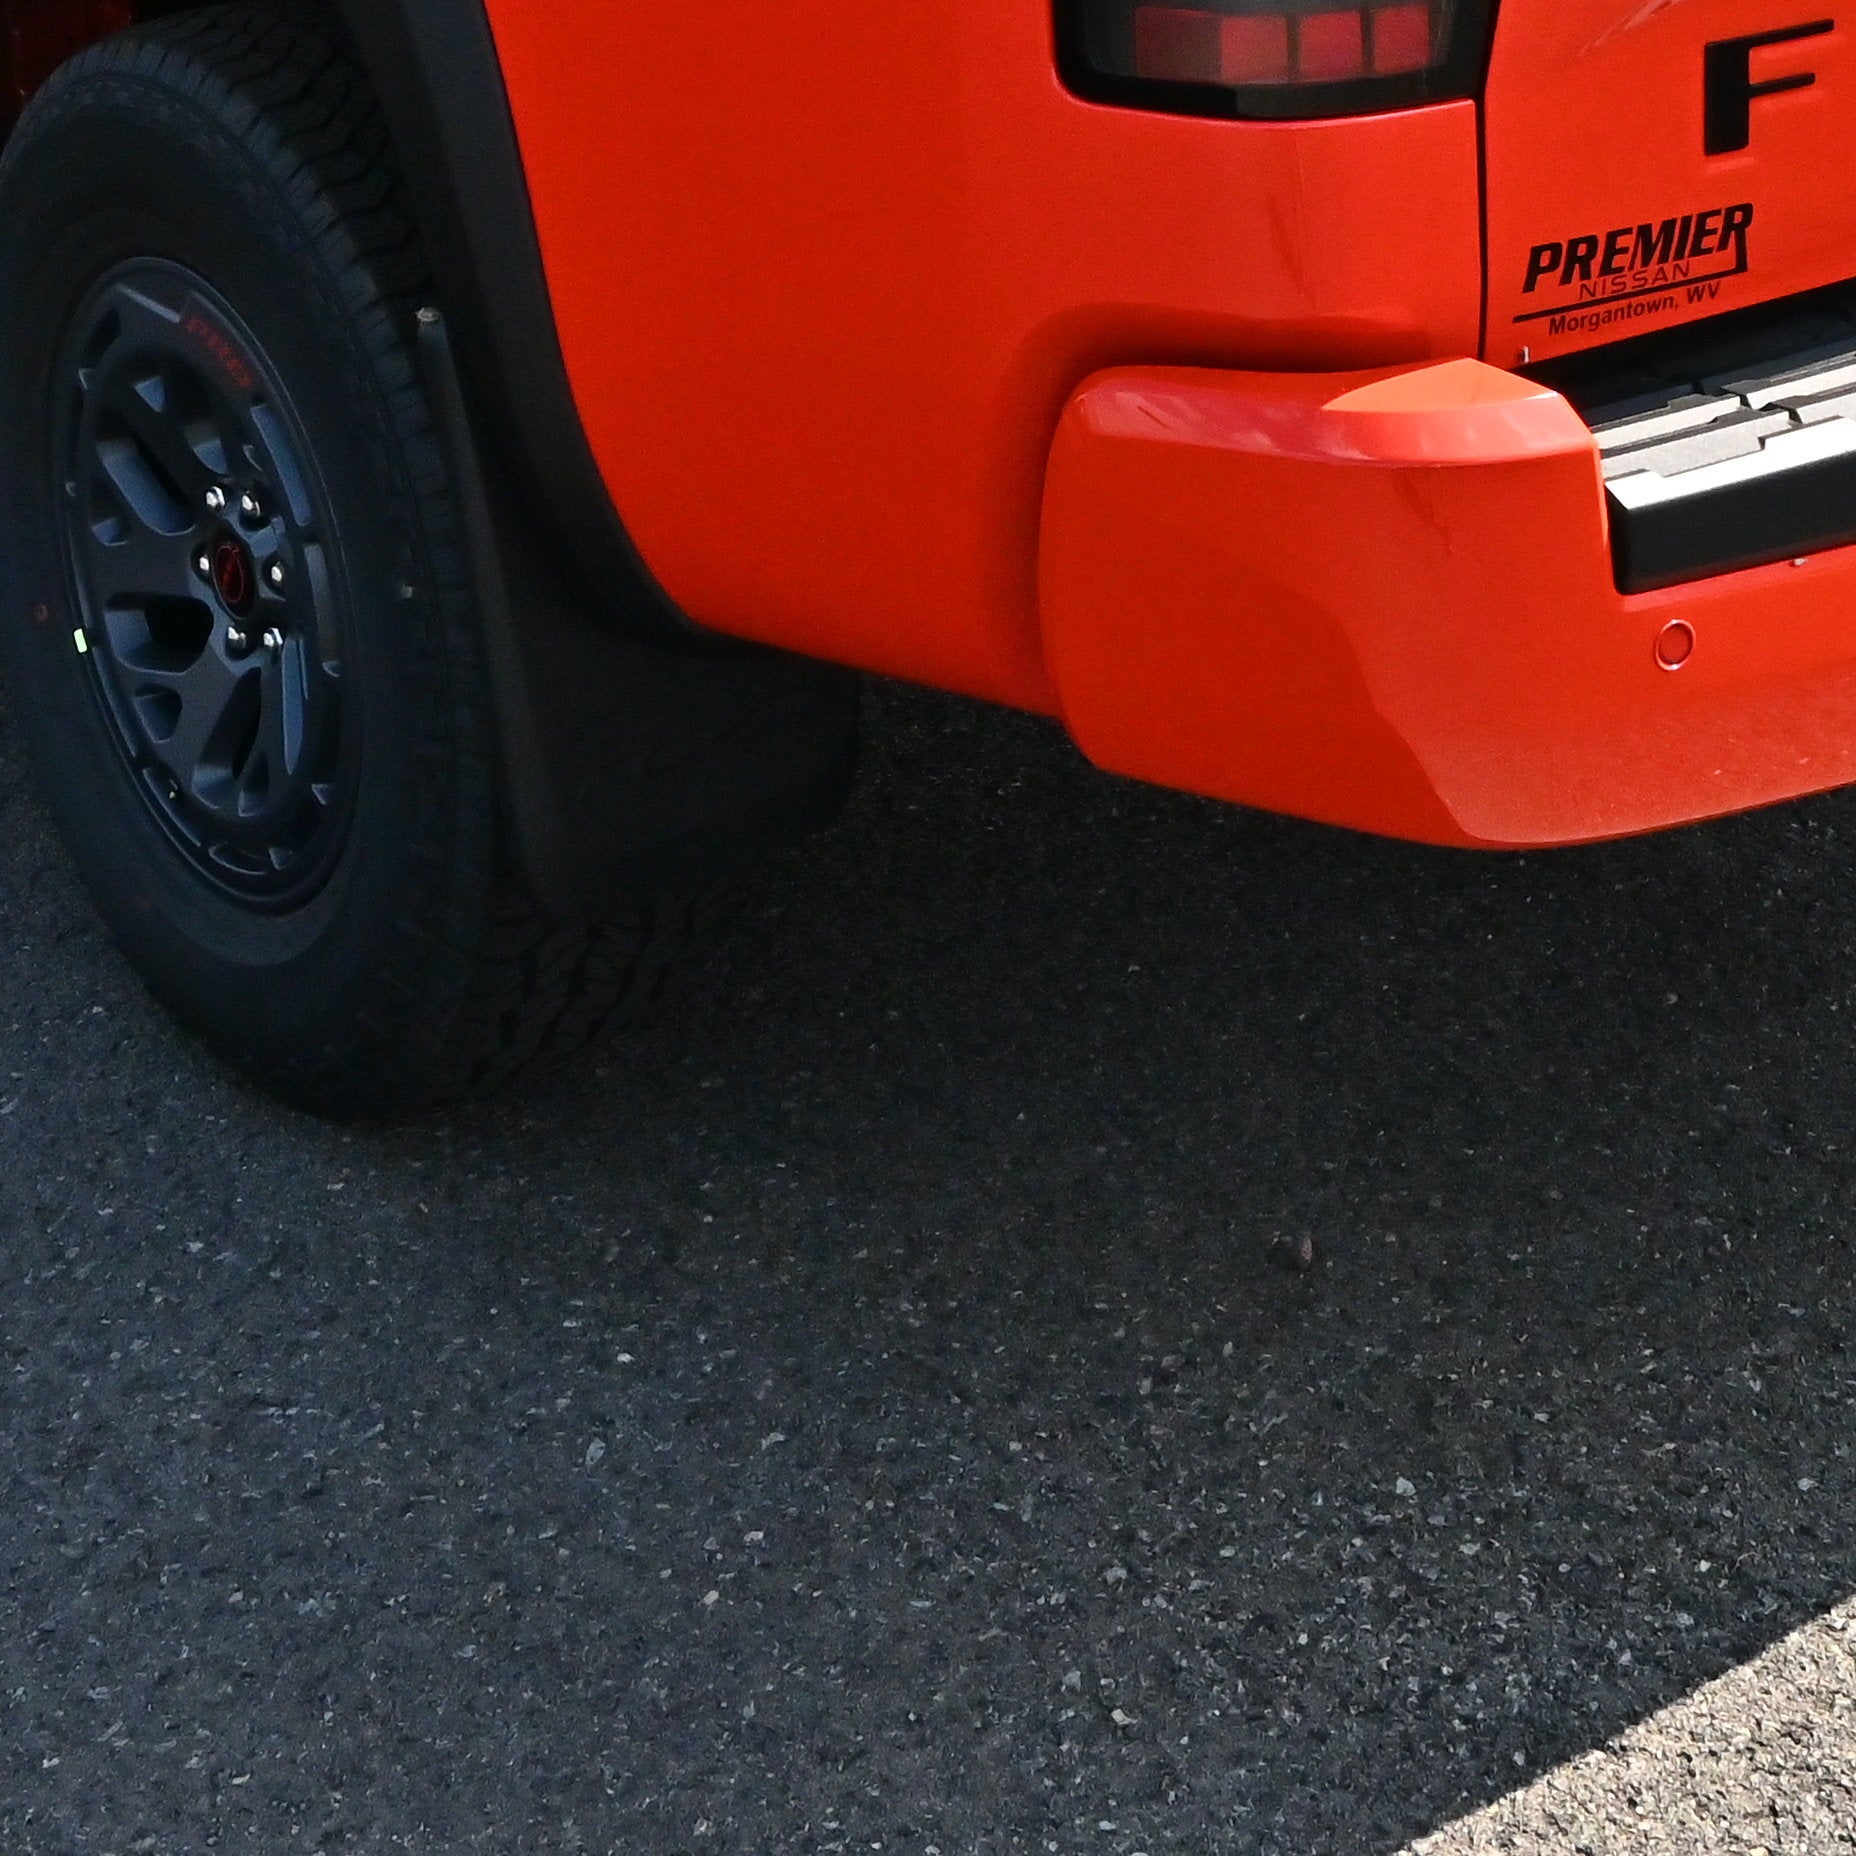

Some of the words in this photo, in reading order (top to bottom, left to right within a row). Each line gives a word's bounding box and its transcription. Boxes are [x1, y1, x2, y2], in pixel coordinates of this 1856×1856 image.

[1521, 202, 1754, 294] PREMIER
[1547, 295, 1680, 337] Morgantown,
[1687, 280, 1722, 305] WV
[1579, 261, 1691, 300] NISSAN
